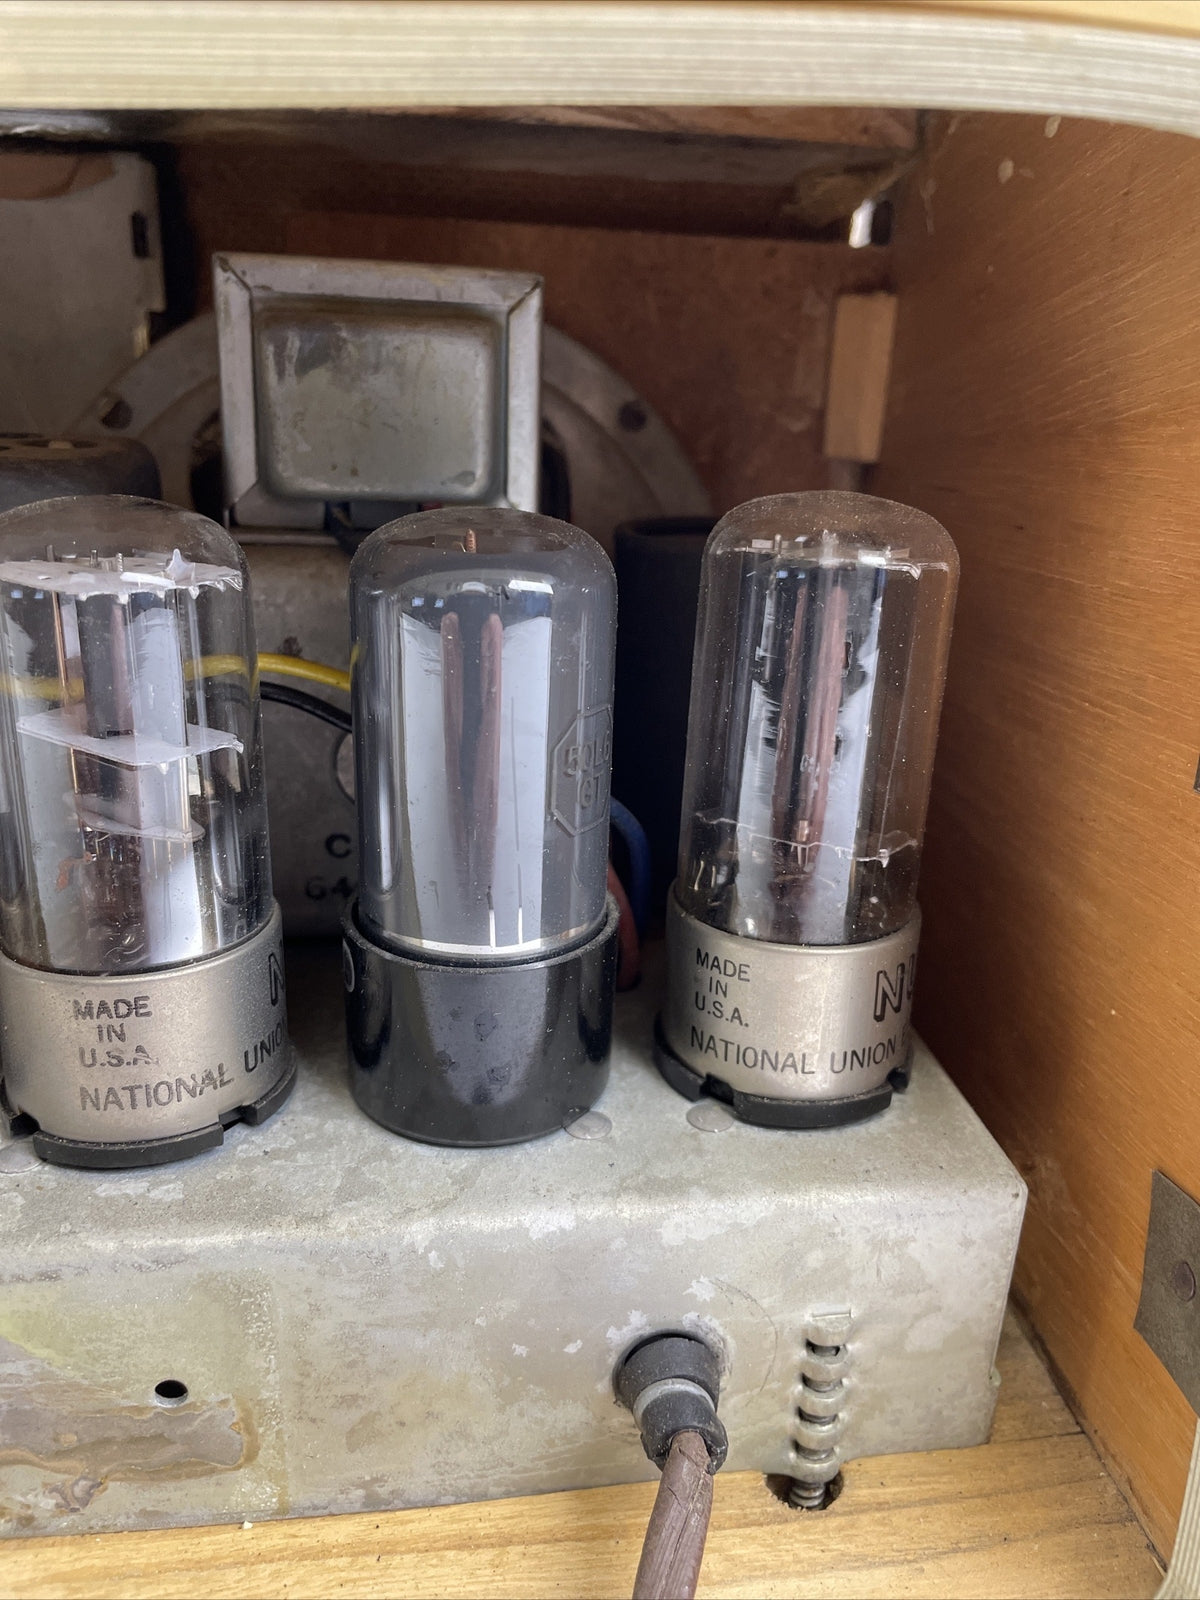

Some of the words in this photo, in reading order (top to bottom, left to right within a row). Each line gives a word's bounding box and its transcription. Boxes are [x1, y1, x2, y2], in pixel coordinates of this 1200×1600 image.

[696, 948, 751, 983] MADE
[708, 977, 728, 998] IN
[71, 995, 153, 1021] MADE
[694, 991, 750, 1028] U.S.A.
[97, 1023, 127, 1043] IN
[690, 1026, 816, 1075] NATIONAL
[830, 1037, 897, 1074] UNION
[79, 1063, 235, 1112] NATIONAL
